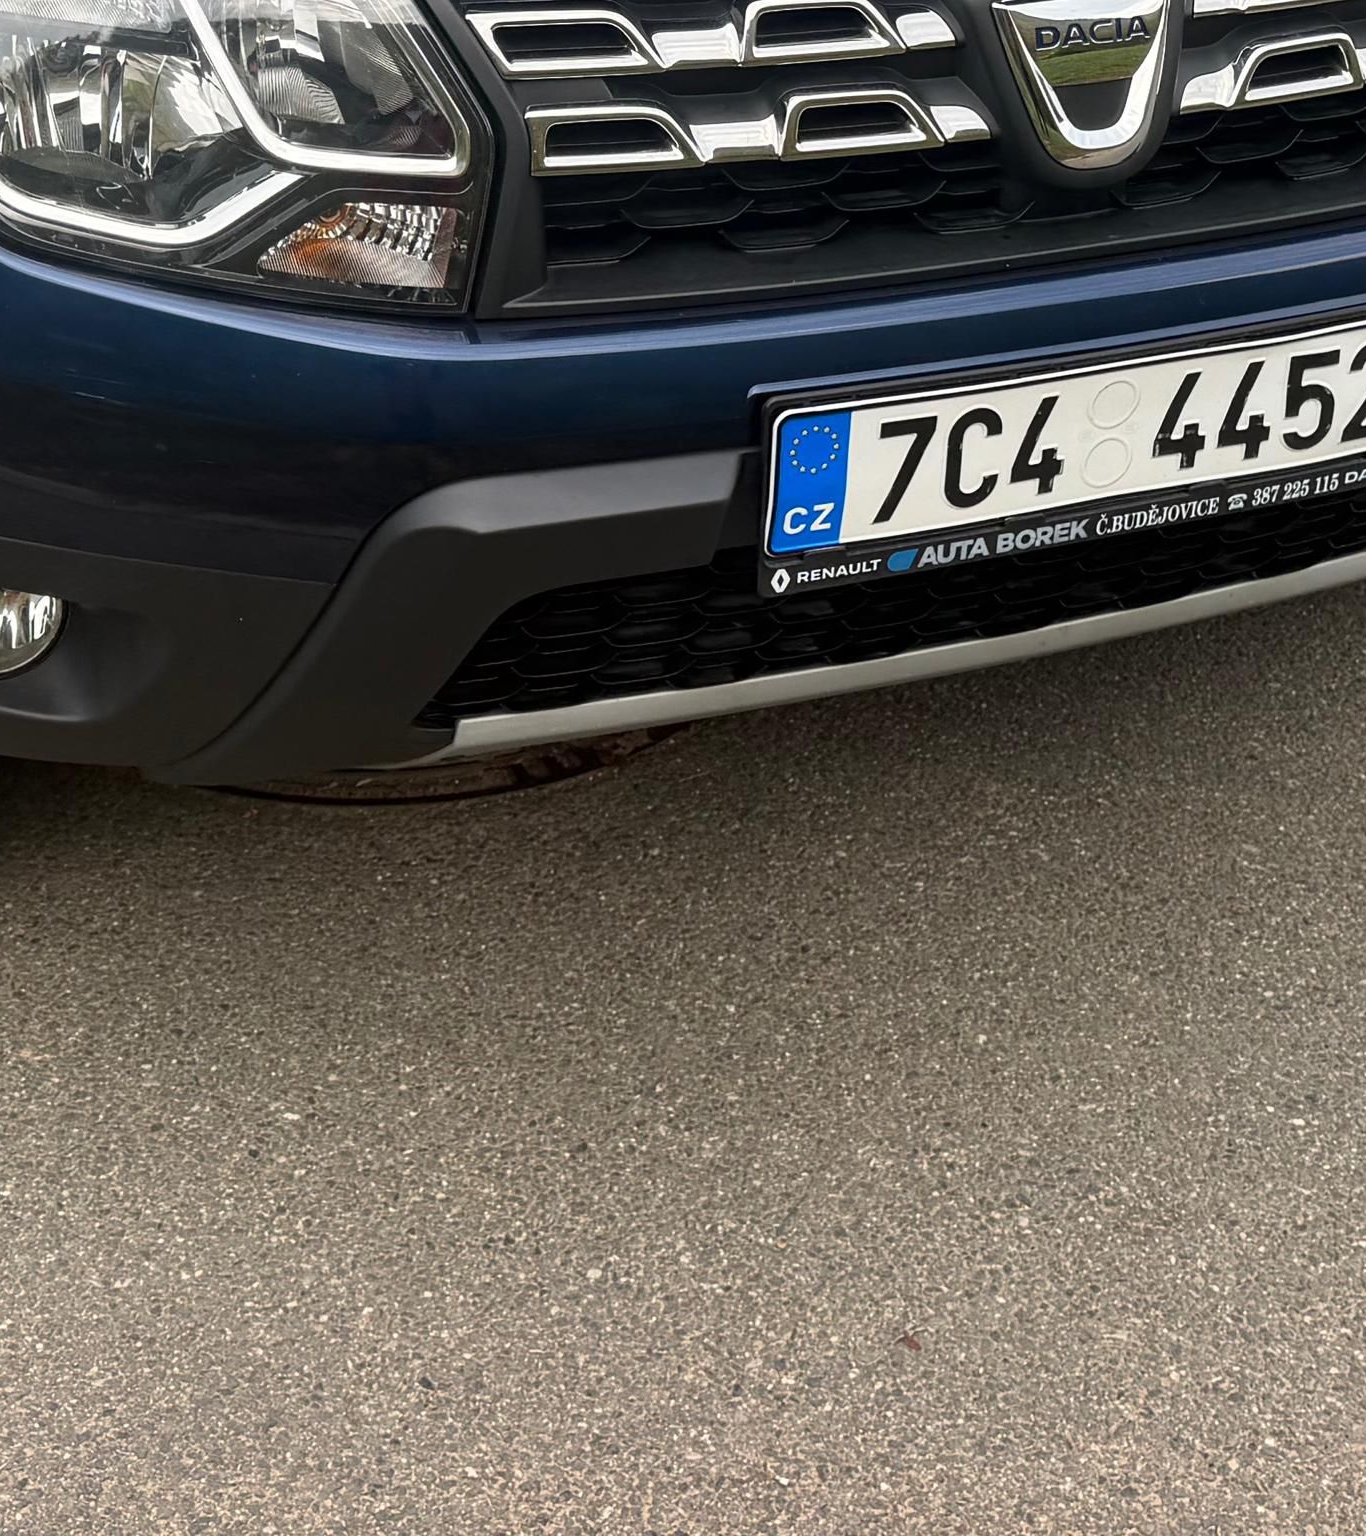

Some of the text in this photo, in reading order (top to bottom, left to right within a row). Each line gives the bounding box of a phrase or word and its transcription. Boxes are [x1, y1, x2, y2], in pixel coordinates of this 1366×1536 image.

[1035, 15, 1151, 52] DACIA
[871, 395, 1065, 525] 7C4
[783, 501, 835, 535] CZ
[796, 558, 883, 584] RENAULT
[917, 536, 991, 569] AUTA
[995, 518, 1091, 554] BOREK
[1095, 495, 1220, 536] Č.BUDĚJOVICE
[1251, 484, 1281, 507] 387
[1282, 478, 1311, 502] 225
[1313, 473, 1340, 496] 115
